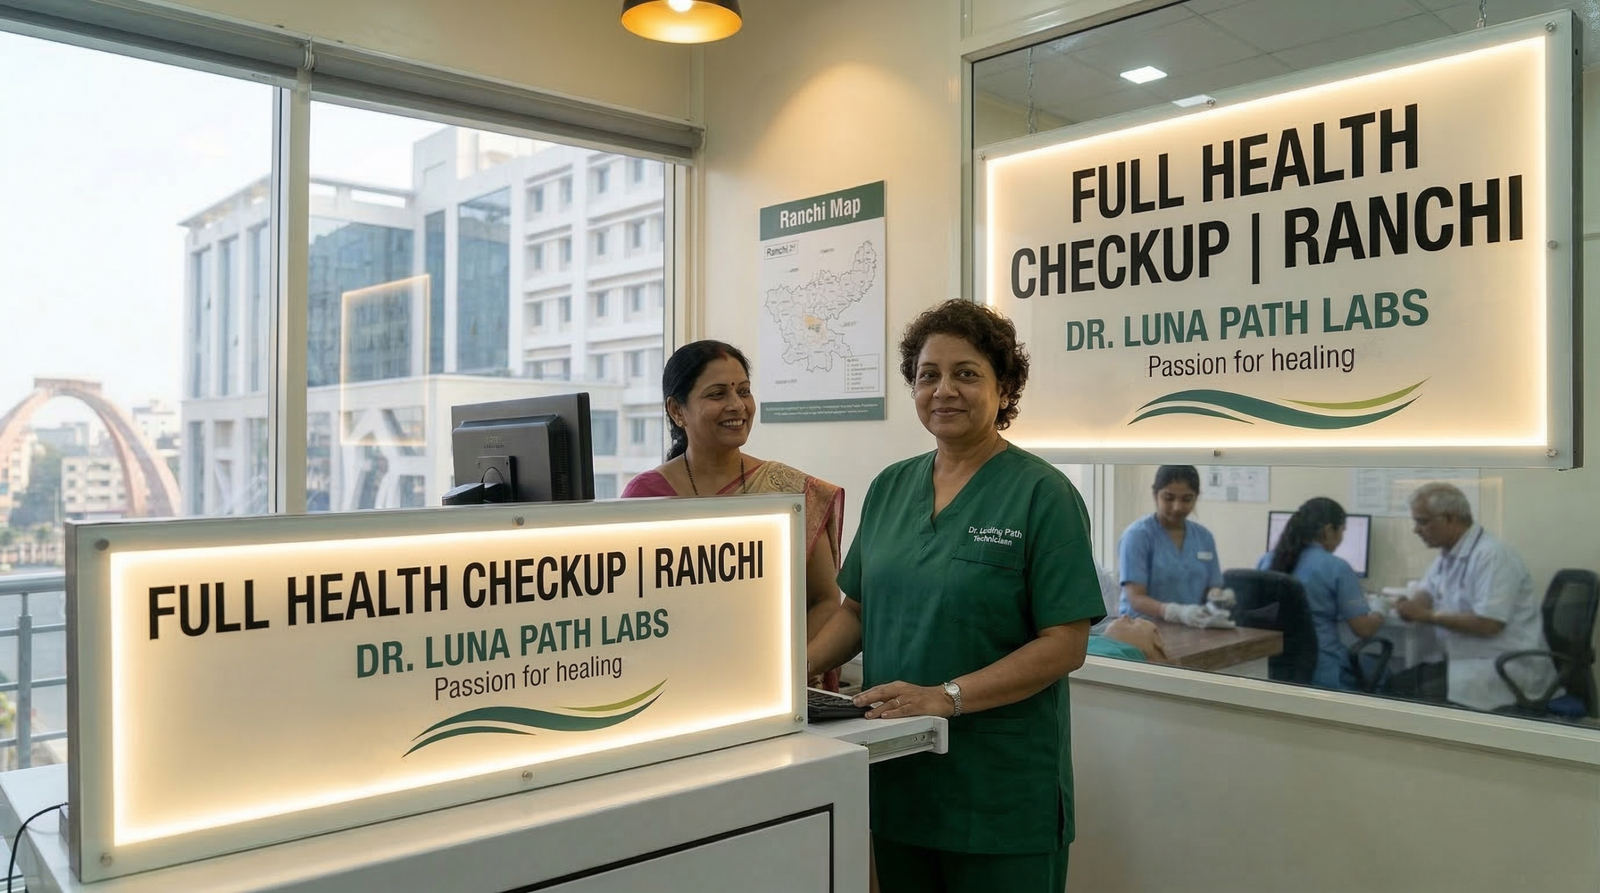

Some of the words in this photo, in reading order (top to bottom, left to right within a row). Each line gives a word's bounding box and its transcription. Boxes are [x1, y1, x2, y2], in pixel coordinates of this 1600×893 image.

[1072, 152, 1185, 224] FULL
[1202, 102, 1419, 204] HEALTH
[780, 201, 826, 229] Ranchi
[830, 197, 861, 219] Map
[1010, 220, 1230, 300] CHECKUP
[1284, 174, 1524, 269] RANCHI
[1066, 318, 1114, 352] DR.
[1124, 308, 1210, 348] LUNA
[1219, 299, 1309, 341] PATH
[1322, 288, 1430, 334] LABS
[1148, 352, 1227, 378] Passion
[1232, 349, 1265, 374] for
[1271, 344, 1355, 374] healing
[968, 526, 978, 534] Dr.
[1004, 528, 1023, 539] Path
[148, 578, 271, 641] FULL
[286, 564, 449, 627] HEALTH
[462, 550, 627, 609] CHECKUP
[654, 539, 764, 590] RANCHI
[356, 640, 414, 679] DR.
[425, 627, 511, 670] LUNA
[520, 617, 592, 657] PATH
[601, 608, 670, 646] LABS
[435, 672, 516, 701] Passion
[521, 664, 551, 688] for
[556, 655, 623, 683] healing
